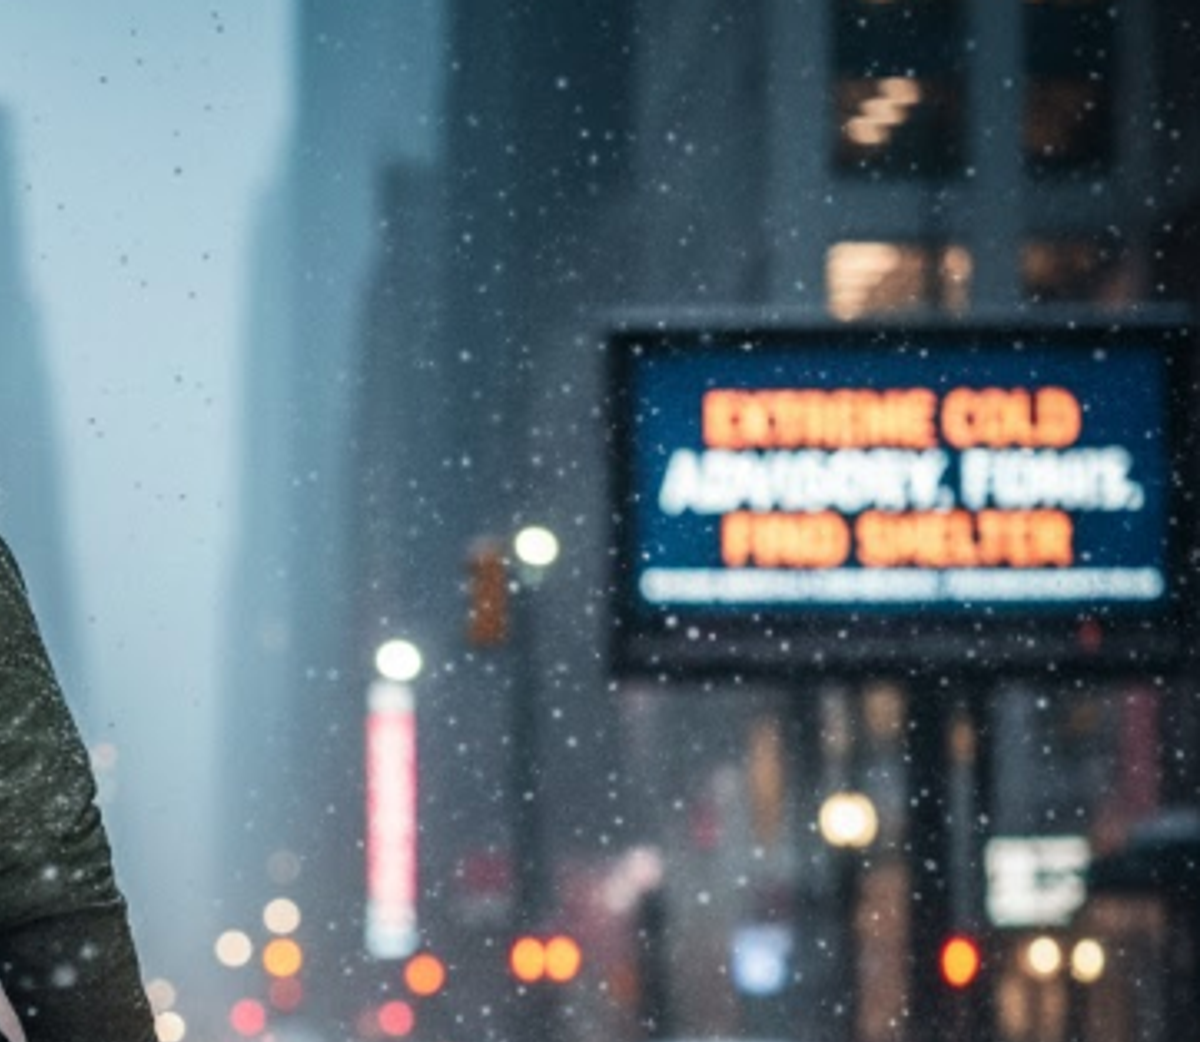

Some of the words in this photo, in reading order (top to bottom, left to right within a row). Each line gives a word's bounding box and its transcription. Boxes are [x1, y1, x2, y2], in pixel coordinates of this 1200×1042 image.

[702, 388, 937, 448] EXTREME
[941, 386, 1081, 448] COLD
[721, 511, 851, 568] FIND
[855, 510, 1074, 568] SHELTER
